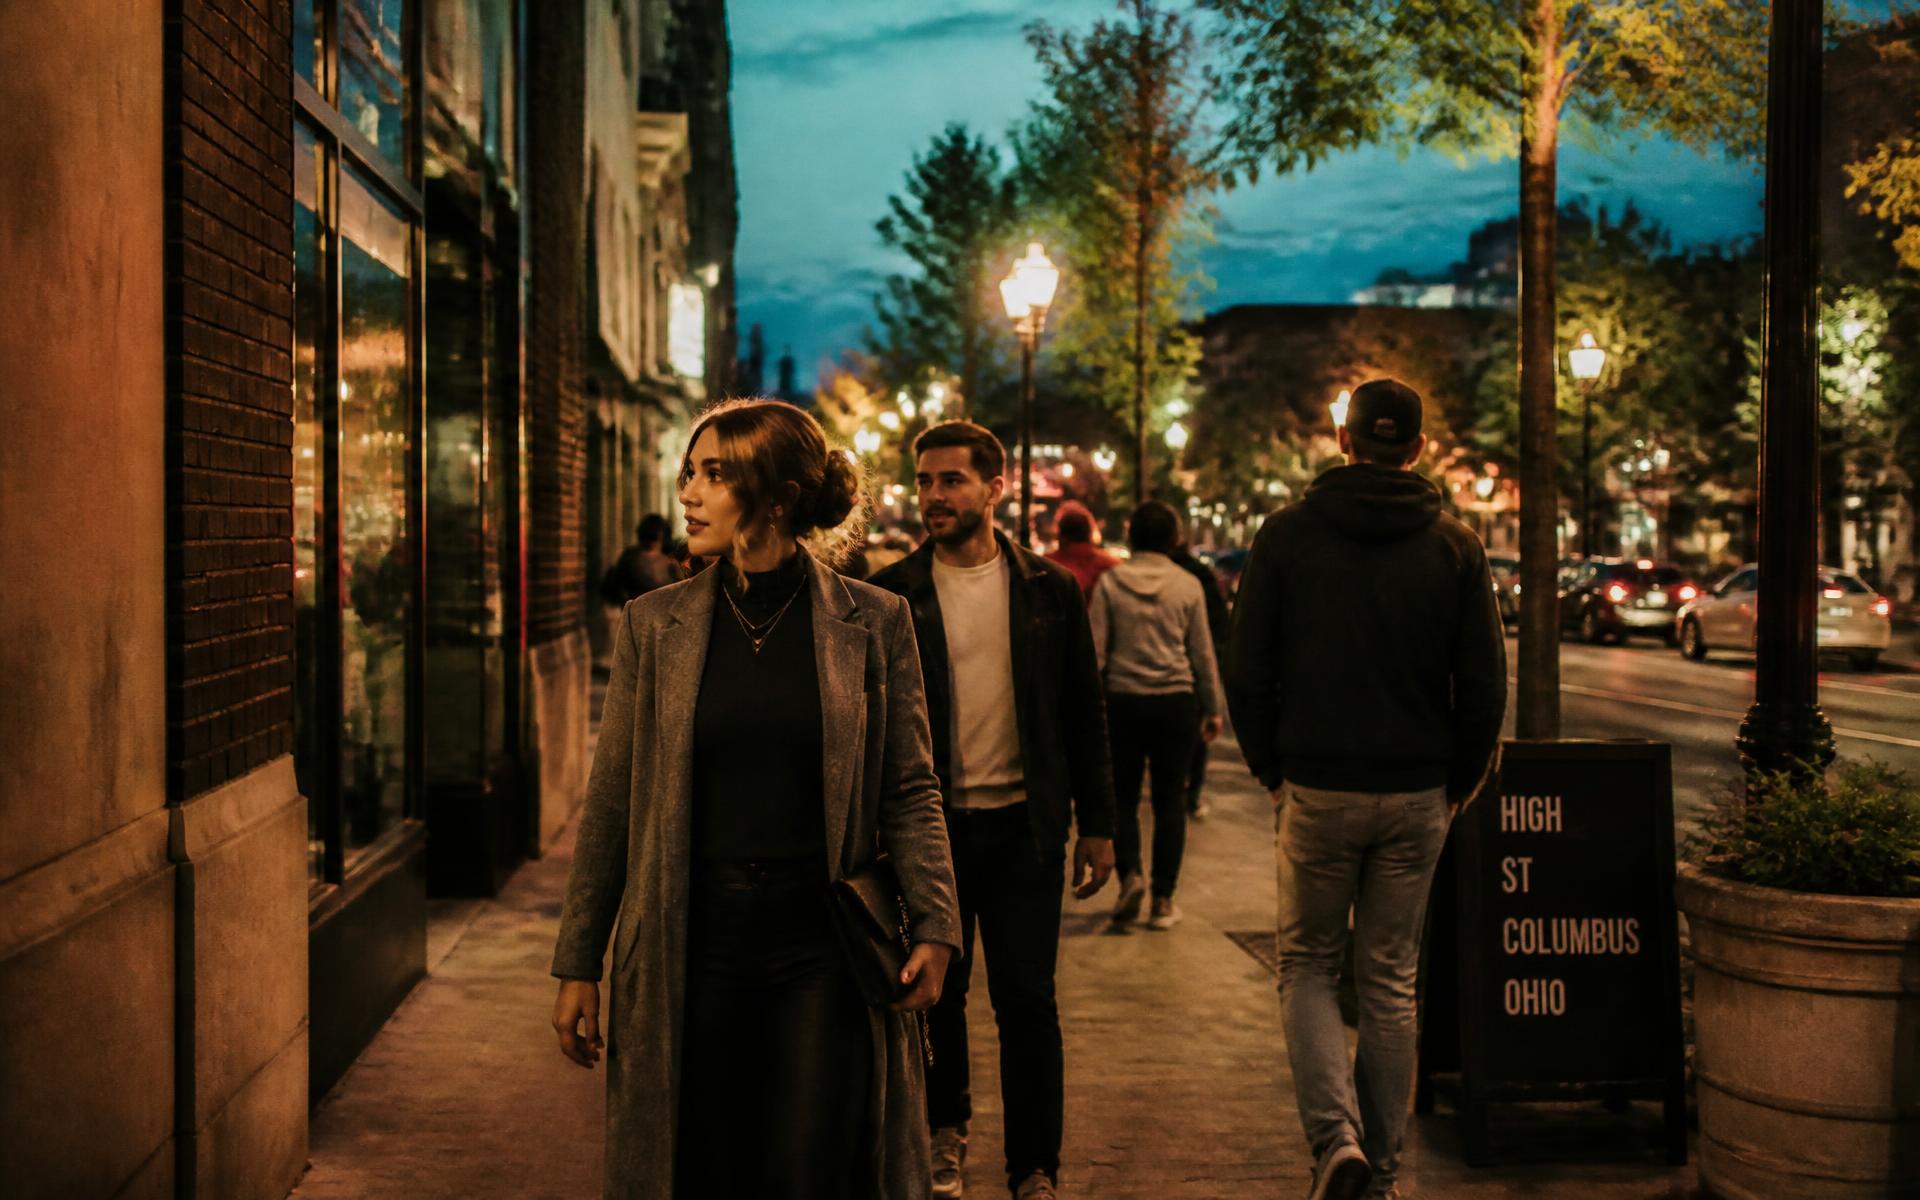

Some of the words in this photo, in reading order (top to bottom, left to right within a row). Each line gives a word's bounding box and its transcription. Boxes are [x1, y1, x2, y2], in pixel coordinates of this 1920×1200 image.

[1501, 796, 1562, 832] HIGH
[1501, 856, 1533, 893] ST
[1503, 918, 1640, 955] COLUMBUS
[1504, 978, 1566, 1016] OHIO
